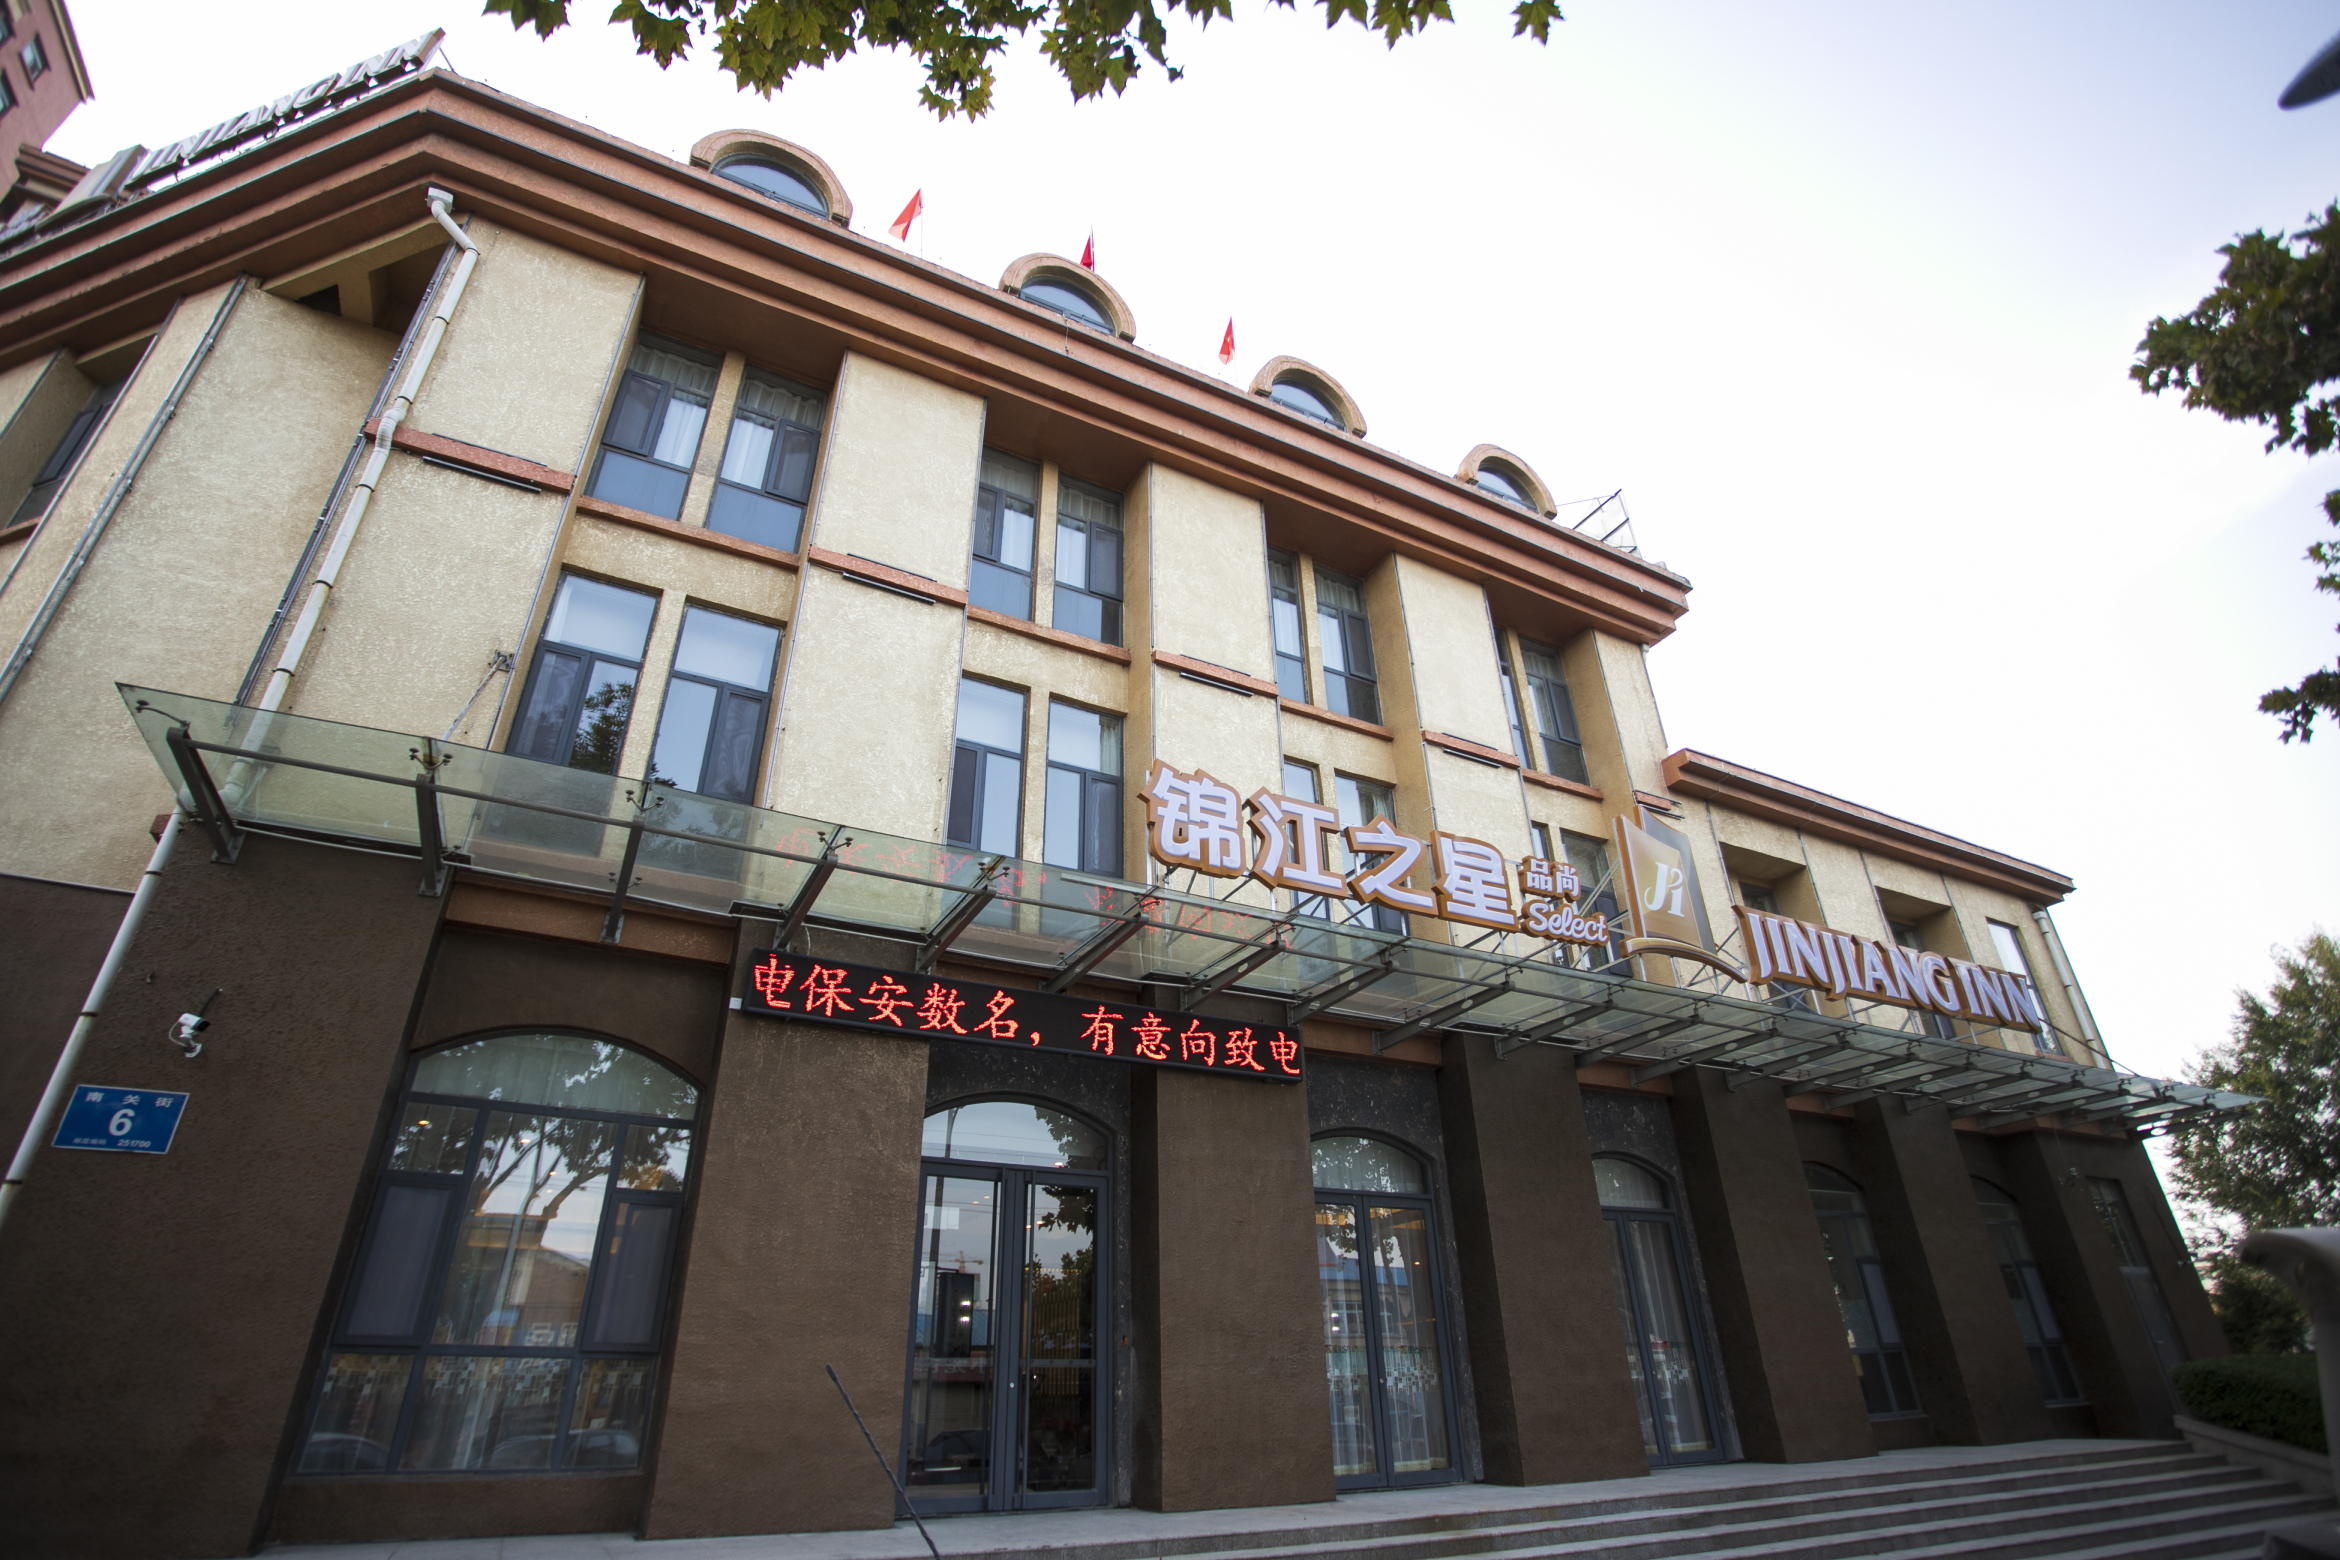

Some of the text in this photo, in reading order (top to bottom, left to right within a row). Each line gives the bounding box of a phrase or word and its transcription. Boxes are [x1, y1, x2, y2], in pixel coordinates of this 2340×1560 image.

[1152, 766, 1518, 927] 锦江之星
[1526, 858, 1579, 898] 品尚
[1528, 902, 1608, 942] Select
[1746, 911, 2041, 1033] JINJIANG INN
[85, 1091, 174, 1109] 南关街
[108, 1108, 136, 1137] 6
[116, 1139, 152, 1149] 251700
